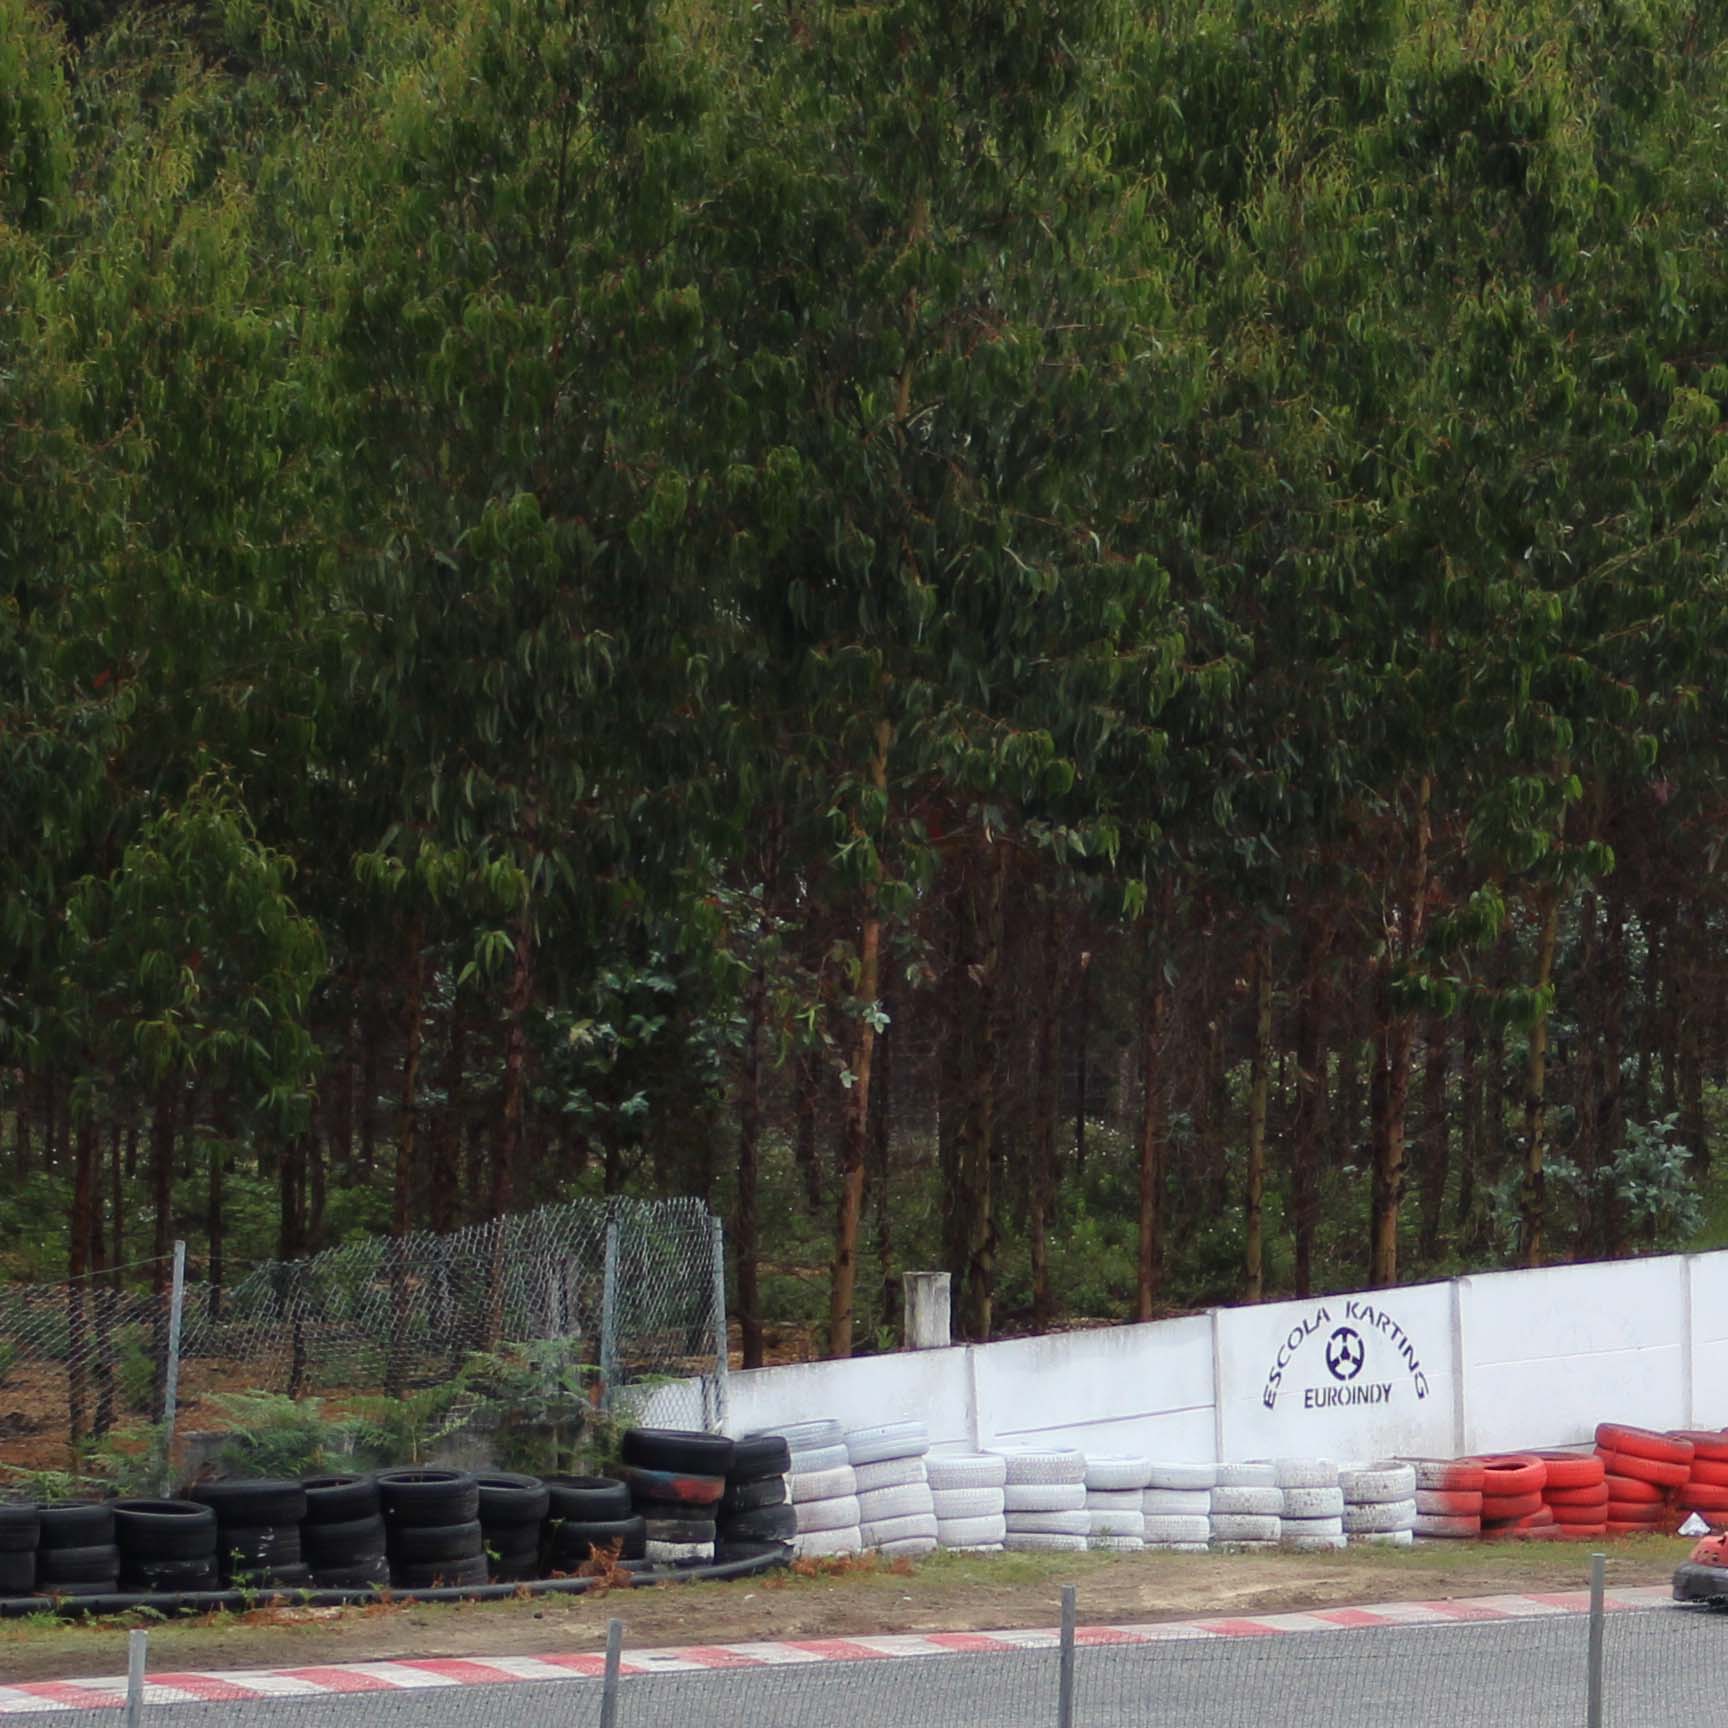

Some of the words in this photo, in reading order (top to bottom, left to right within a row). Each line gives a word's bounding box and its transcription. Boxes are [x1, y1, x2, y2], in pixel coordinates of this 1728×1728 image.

[1263, 1307, 1331, 1411] ESCOLA
[1346, 1301, 1430, 1400] KARTING
[1304, 1383, 1393, 1409] EUROINDY
